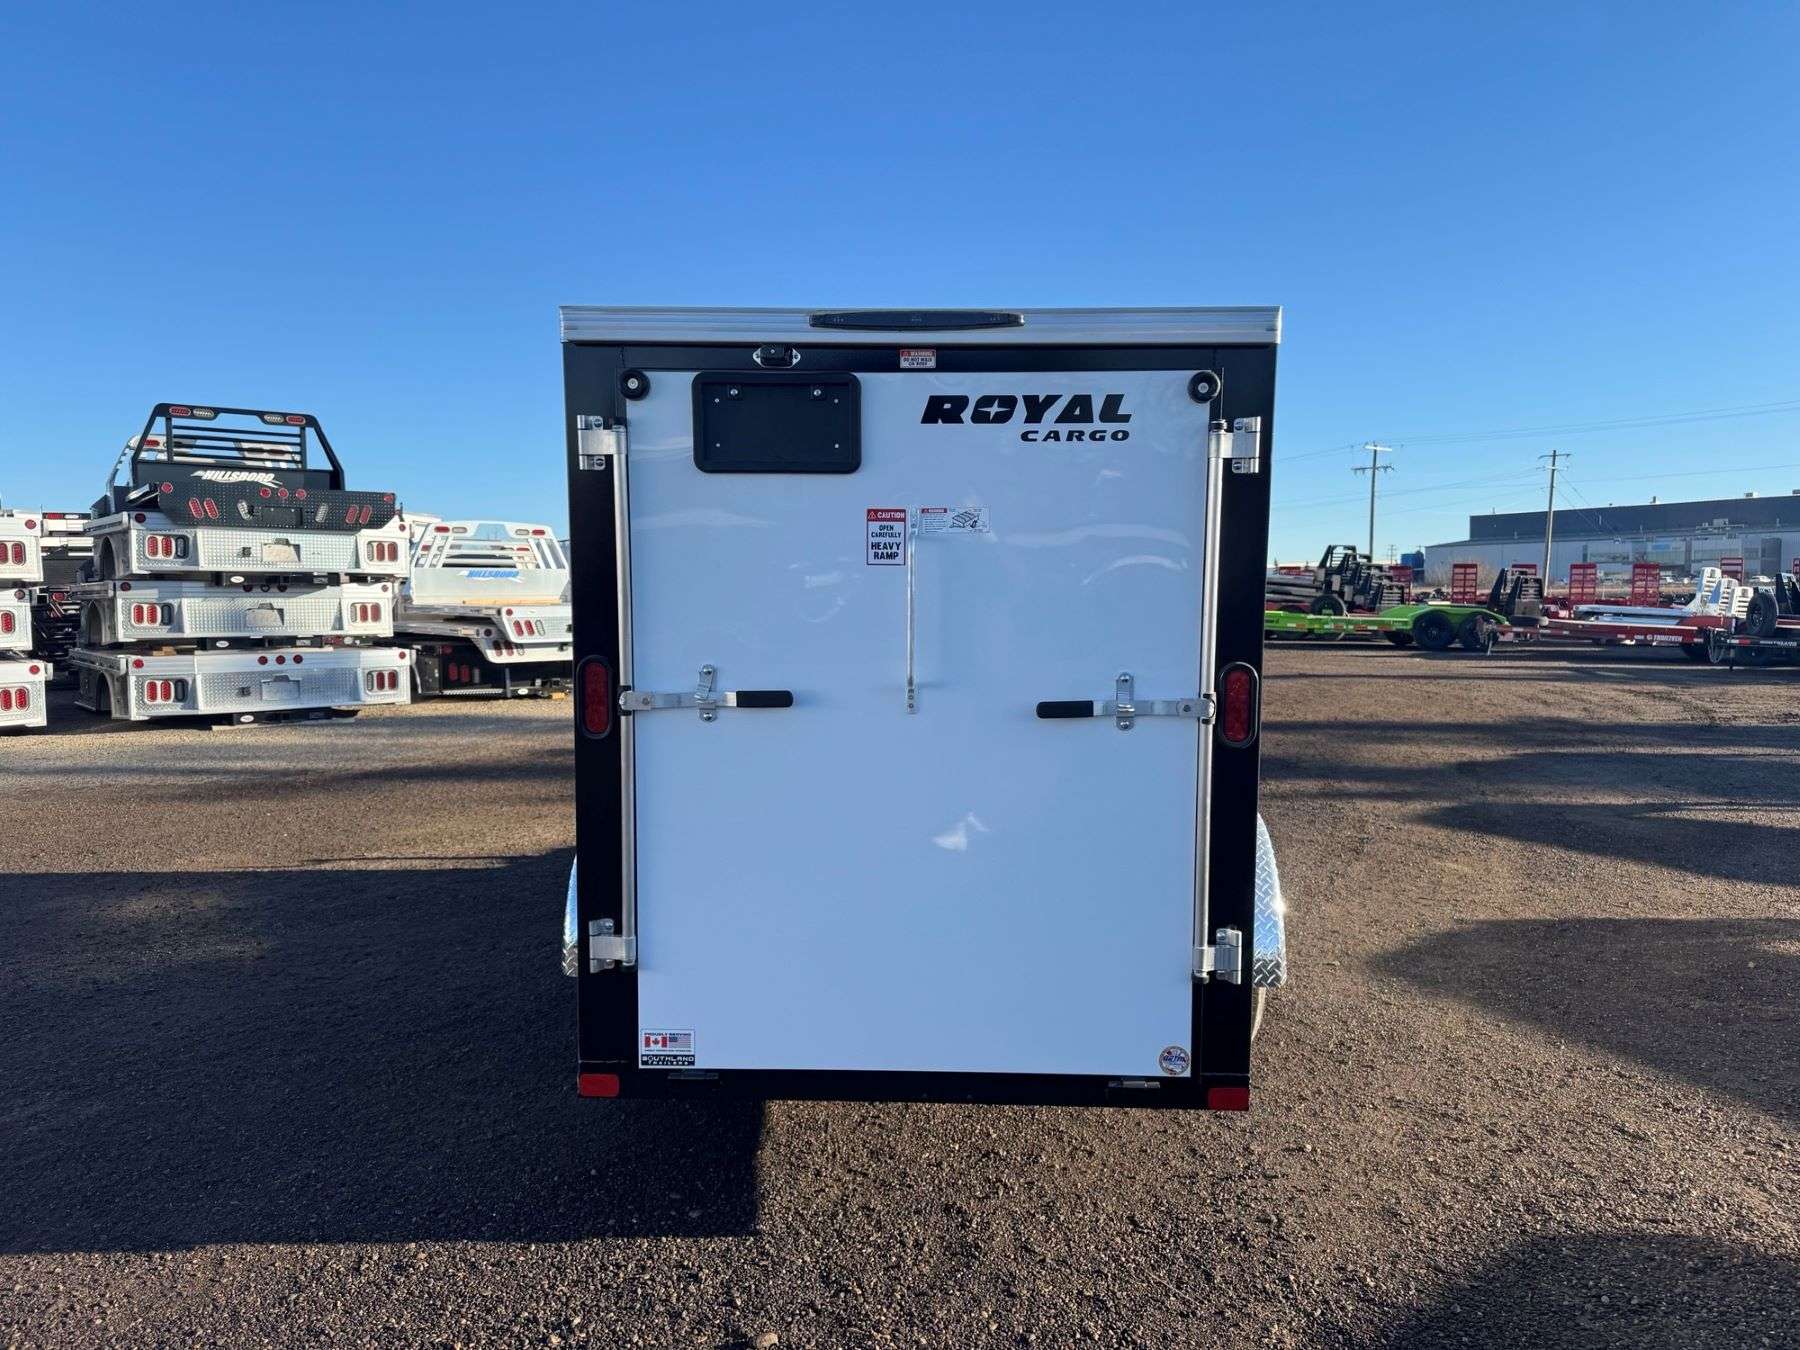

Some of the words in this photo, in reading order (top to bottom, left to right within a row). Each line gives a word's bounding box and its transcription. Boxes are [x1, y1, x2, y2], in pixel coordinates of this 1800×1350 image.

[920, 393, 1132, 425] ROYAL
[1020, 429, 1130, 442] CARGO
[202, 470, 275, 482] HILLSBORO
[877, 511, 905, 519] CAUTION
[871, 541, 901, 551] HEAVY
[873, 551, 899, 560] RAMP
